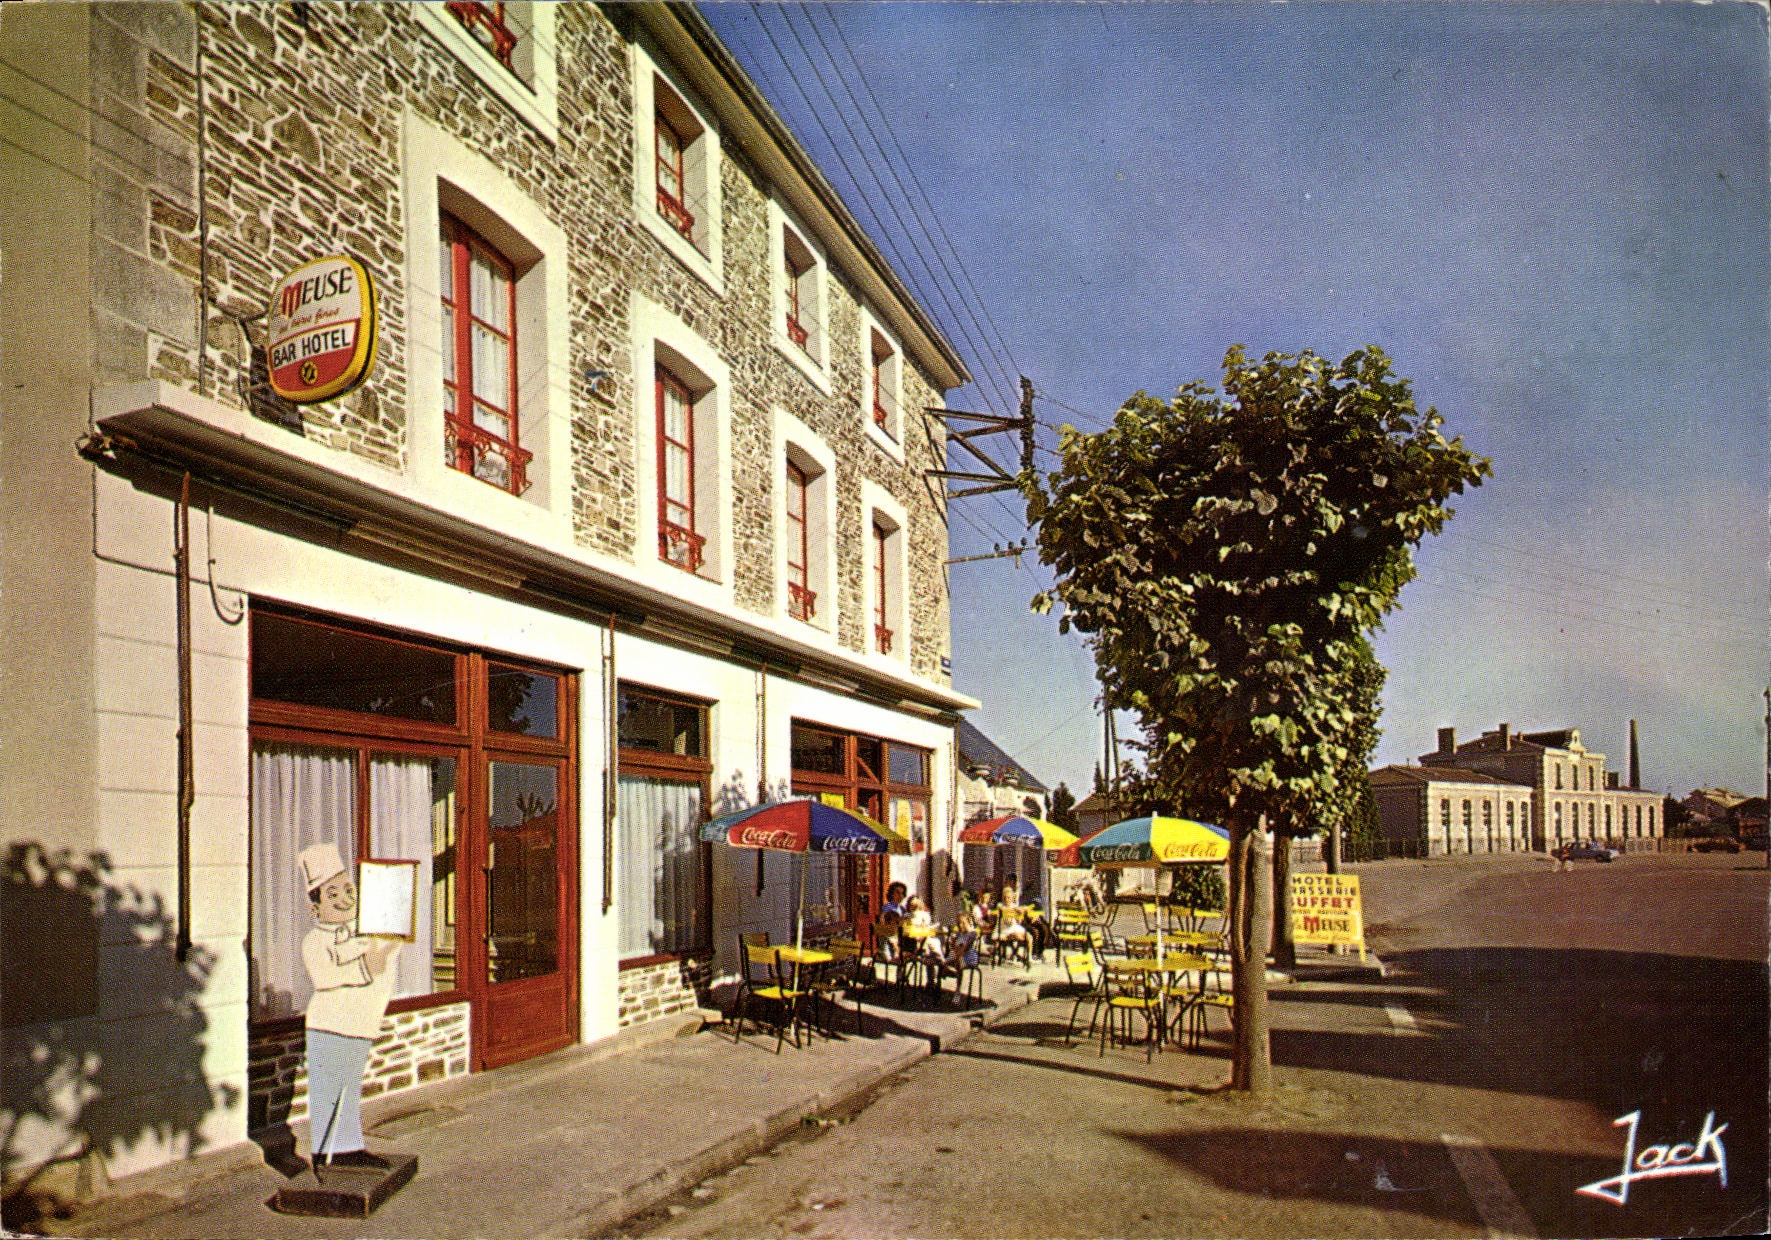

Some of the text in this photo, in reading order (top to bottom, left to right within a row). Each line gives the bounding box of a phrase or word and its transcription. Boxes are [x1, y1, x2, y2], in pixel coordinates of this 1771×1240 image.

[280, 266, 352, 319] MEUSE
[273, 328, 351, 368] BAR HOTEL
[1292, 876, 1343, 885] HOTEL
[1291, 897, 1353, 908] UFFET
[1303, 916, 1350, 934] MEUSE
